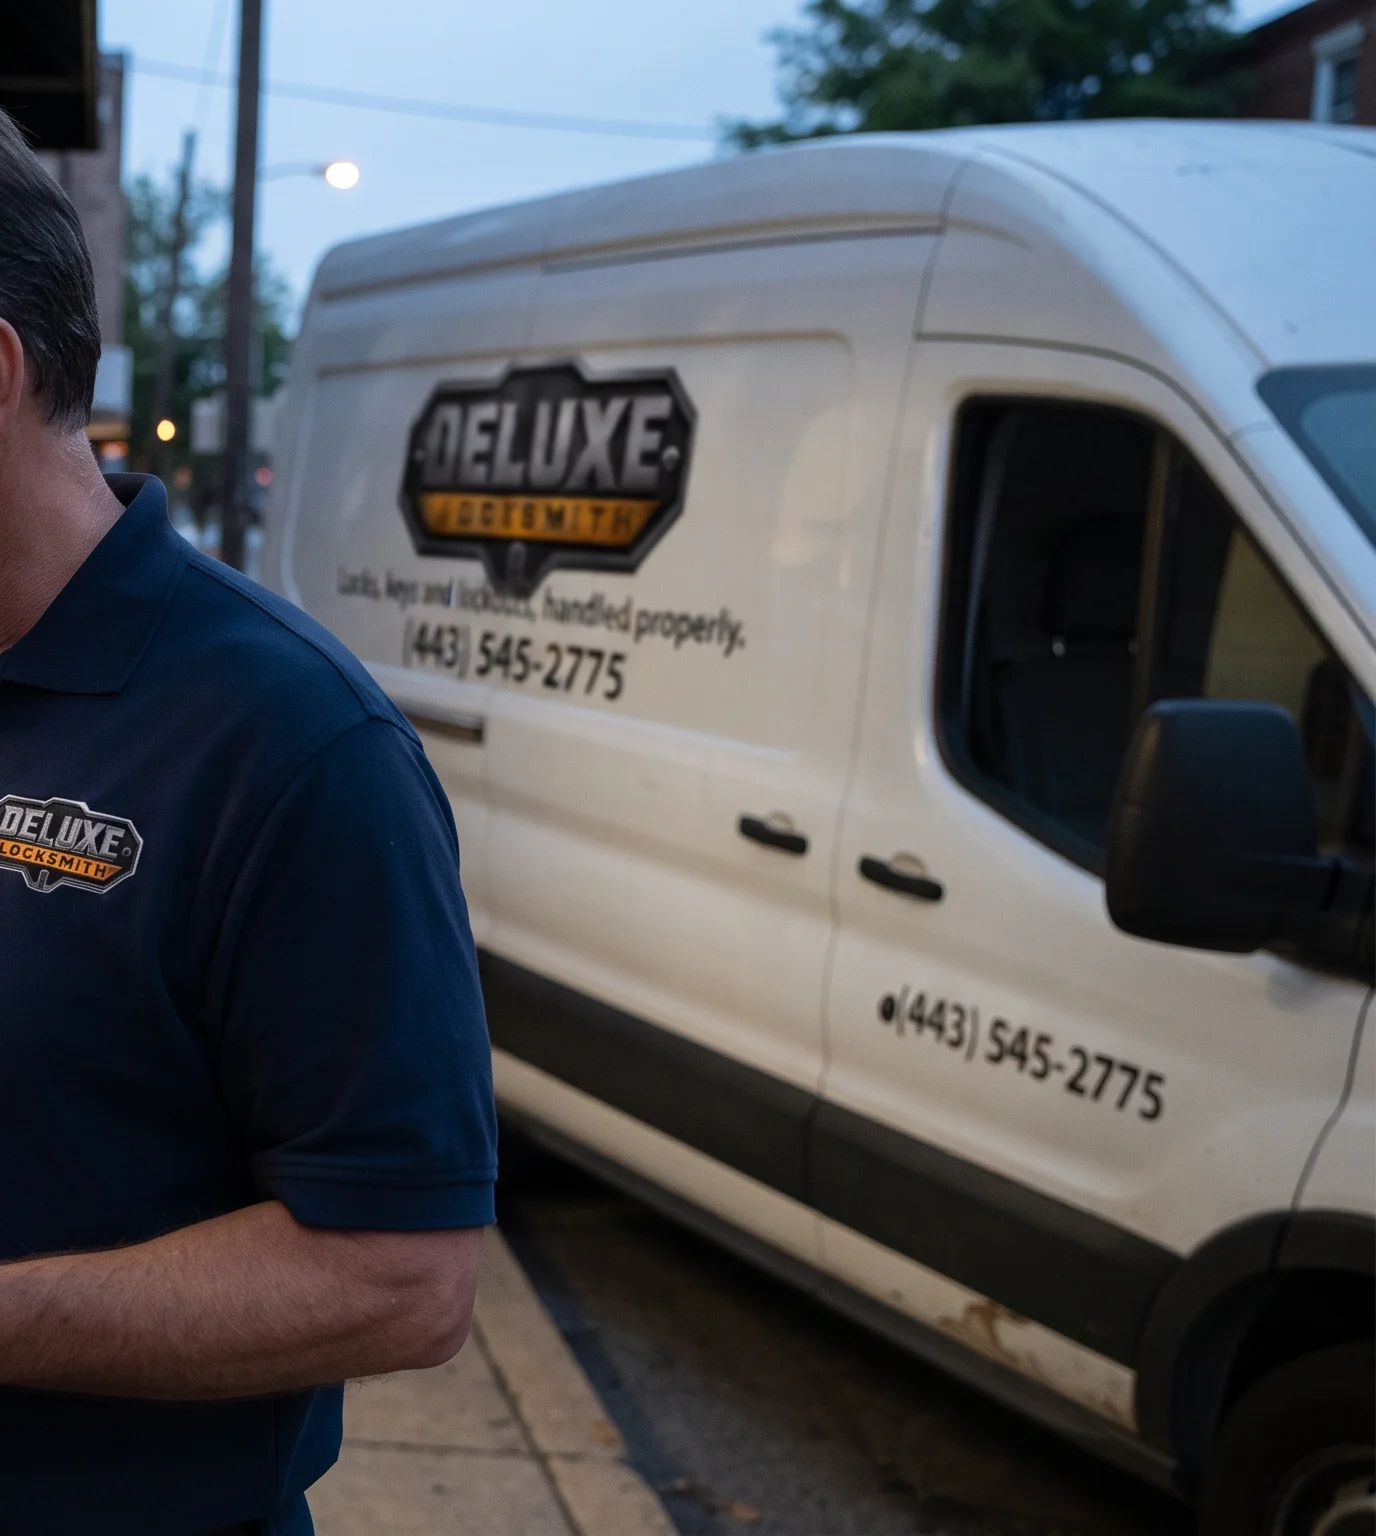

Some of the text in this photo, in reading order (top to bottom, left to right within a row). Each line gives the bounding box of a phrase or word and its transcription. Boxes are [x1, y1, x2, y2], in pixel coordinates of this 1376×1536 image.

[426, 395, 672, 490] DELUXE
[430, 498, 635, 536] LOCKSMITH
[401, 614, 627, 701] (443) 545-2775
[422, 576, 453, 608] and
[541, 586, 633, 634] handled
[634, 605, 747, 659] properly.
[895, 983, 1166, 1123] (443) 545-2775
